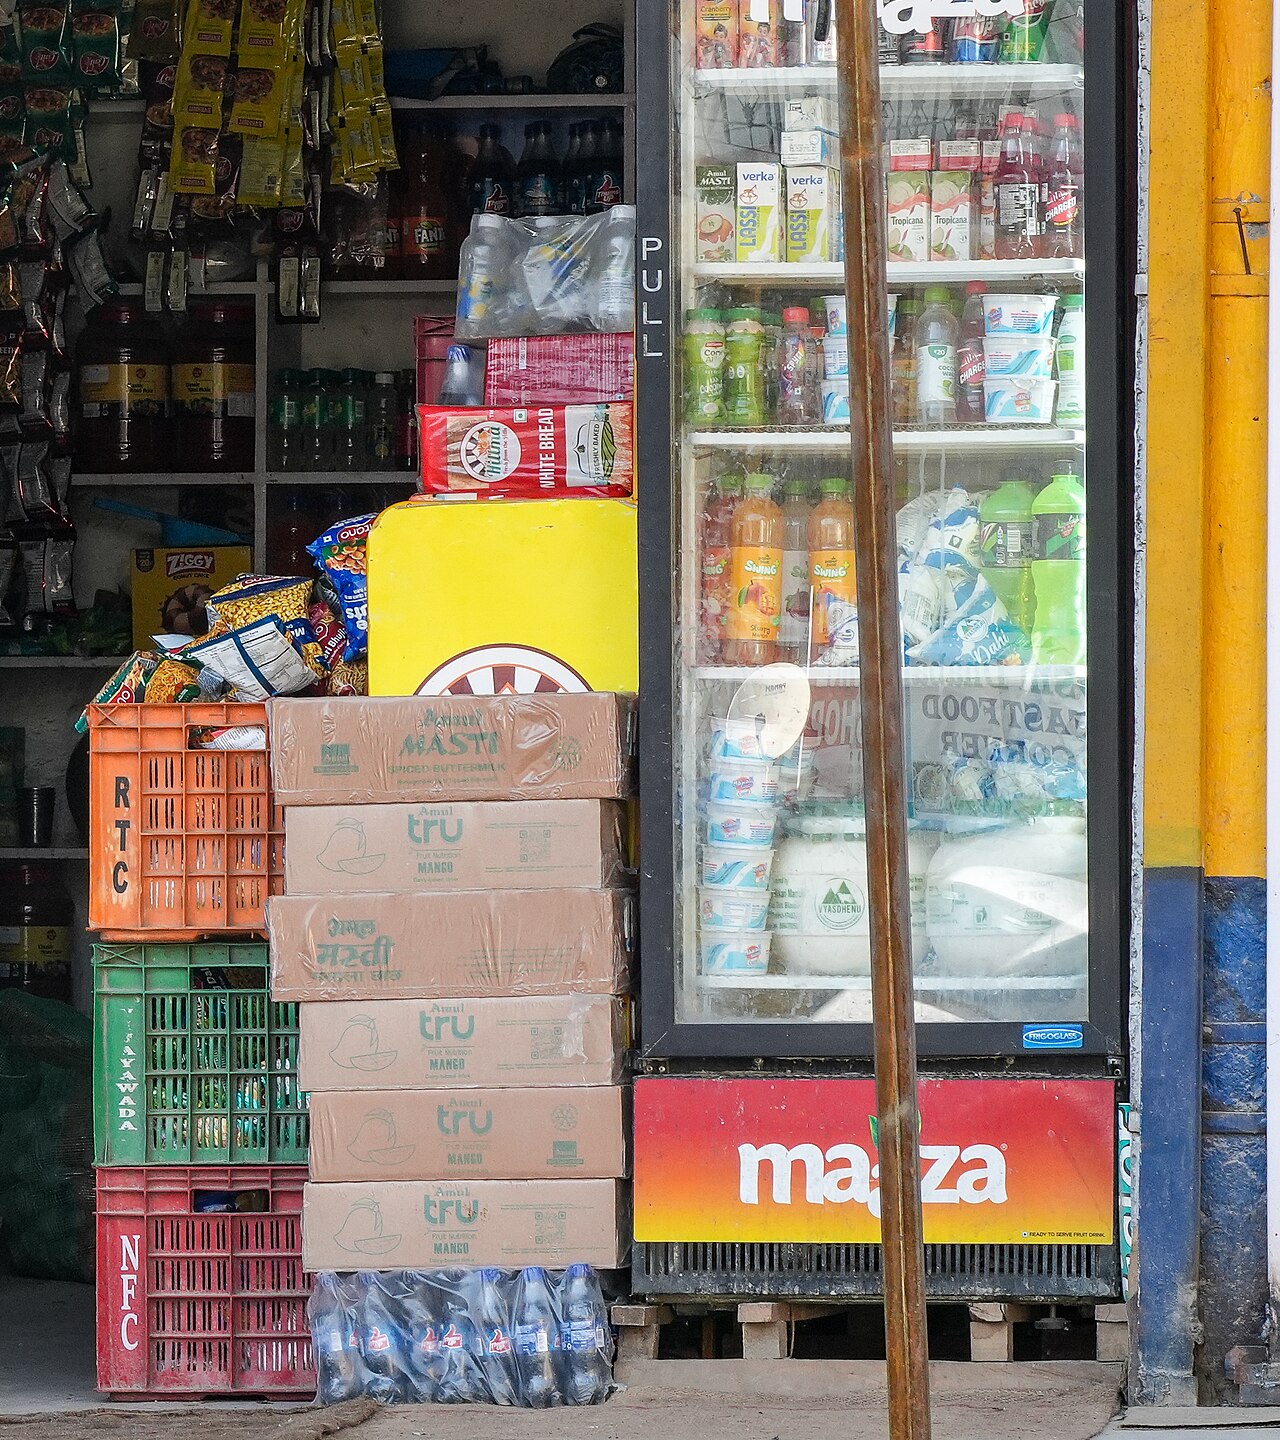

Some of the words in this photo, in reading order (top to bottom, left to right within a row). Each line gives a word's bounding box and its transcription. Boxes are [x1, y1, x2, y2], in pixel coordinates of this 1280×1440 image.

[700, 5, 732, 15] Cranberry
[700, 177, 731, 186] MASTI
[742, 171, 774, 182] verka
[792, 175, 823, 186] verka
[1045, 196, 1077, 222] CHARGED
[740, 205, 757, 247] LASSI
[891, 215, 923, 227] Tropicana
[935, 214, 968, 226] Tropicana
[790, 209, 807, 251] LASSI
[642, 236, 664, 358] PULL
[959, 361, 986, 385] CHARGE
[537, 408, 555, 451] BREAD
[487, 425, 502, 477] Hillma
[539, 452, 556, 489] WHITE
[594, 449, 602, 478] FRESHLY
[167, 553, 215, 577] ZIGGY
[744, 560, 777, 575] SWING
[814, 564, 847, 578] SWING
[972, 629, 1010, 665] Dahi
[399, 731, 500, 758] MASTI
[387, 764, 432, 774] SPICED
[432, 762, 506, 773] BUTTERMILK
[418, 806, 454, 817] Amul
[111, 775, 133, 895] RTC
[407, 813, 464, 845] tru
[415, 851, 431, 859] Fruit
[432, 850, 462, 859] Nutrition
[417, 861, 454, 875] MANGO
[818, 904, 862, 915] VYASDHENU
[316, 934, 396, 969] मस्ती
[430, 1002, 465, 1013] Amul
[418, 1010, 475, 1041] tru
[1028, 1031, 1078, 1041] FRIGOGLASS
[427, 1048, 443, 1056] Fruit
[444, 1048, 474, 1056] Nutrition
[429, 1058, 465, 1071] MANGO
[448, 1097, 483, 1108] Amul
[437, 1104, 493, 1136] tru
[447, 1152, 483, 1165] MANGO
[737, 1142, 1008, 1220] maza
[434, 1187, 471, 1198] Amul
[423, 1194, 480, 1225] tru
[431, 1232, 447, 1241] Fruit
[448, 1232, 478, 1241] Nutrition
[433, 1242, 470, 1255] MANGO
[120, 1233, 142, 1352] NFC
